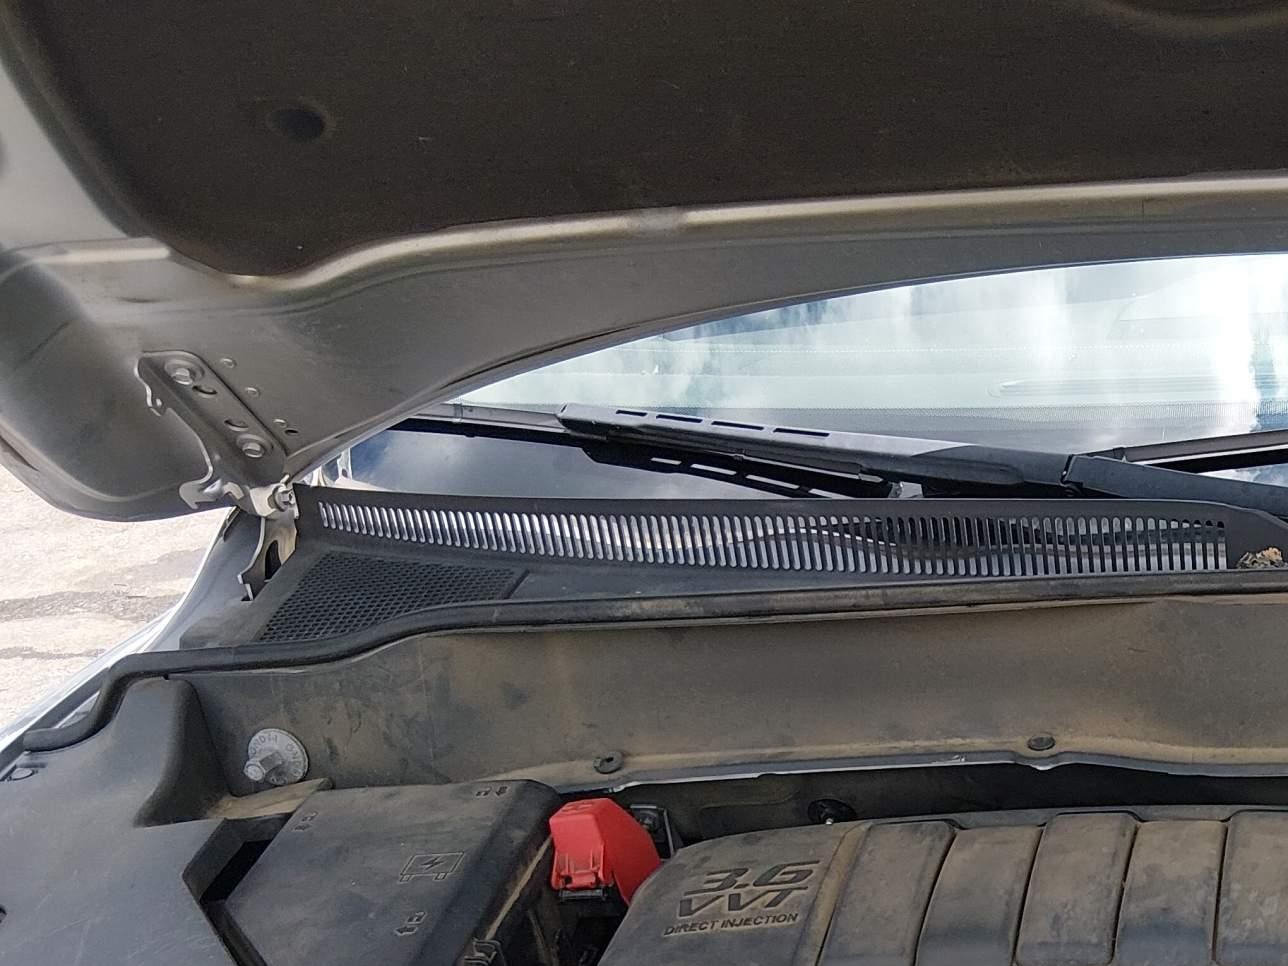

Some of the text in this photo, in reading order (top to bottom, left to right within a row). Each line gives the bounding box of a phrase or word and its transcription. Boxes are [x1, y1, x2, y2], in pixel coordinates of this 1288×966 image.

[683, 860, 820, 896] 3.6
[678, 886, 808, 917] VVT
[664, 912, 798, 936] DIRECT INJECTION
